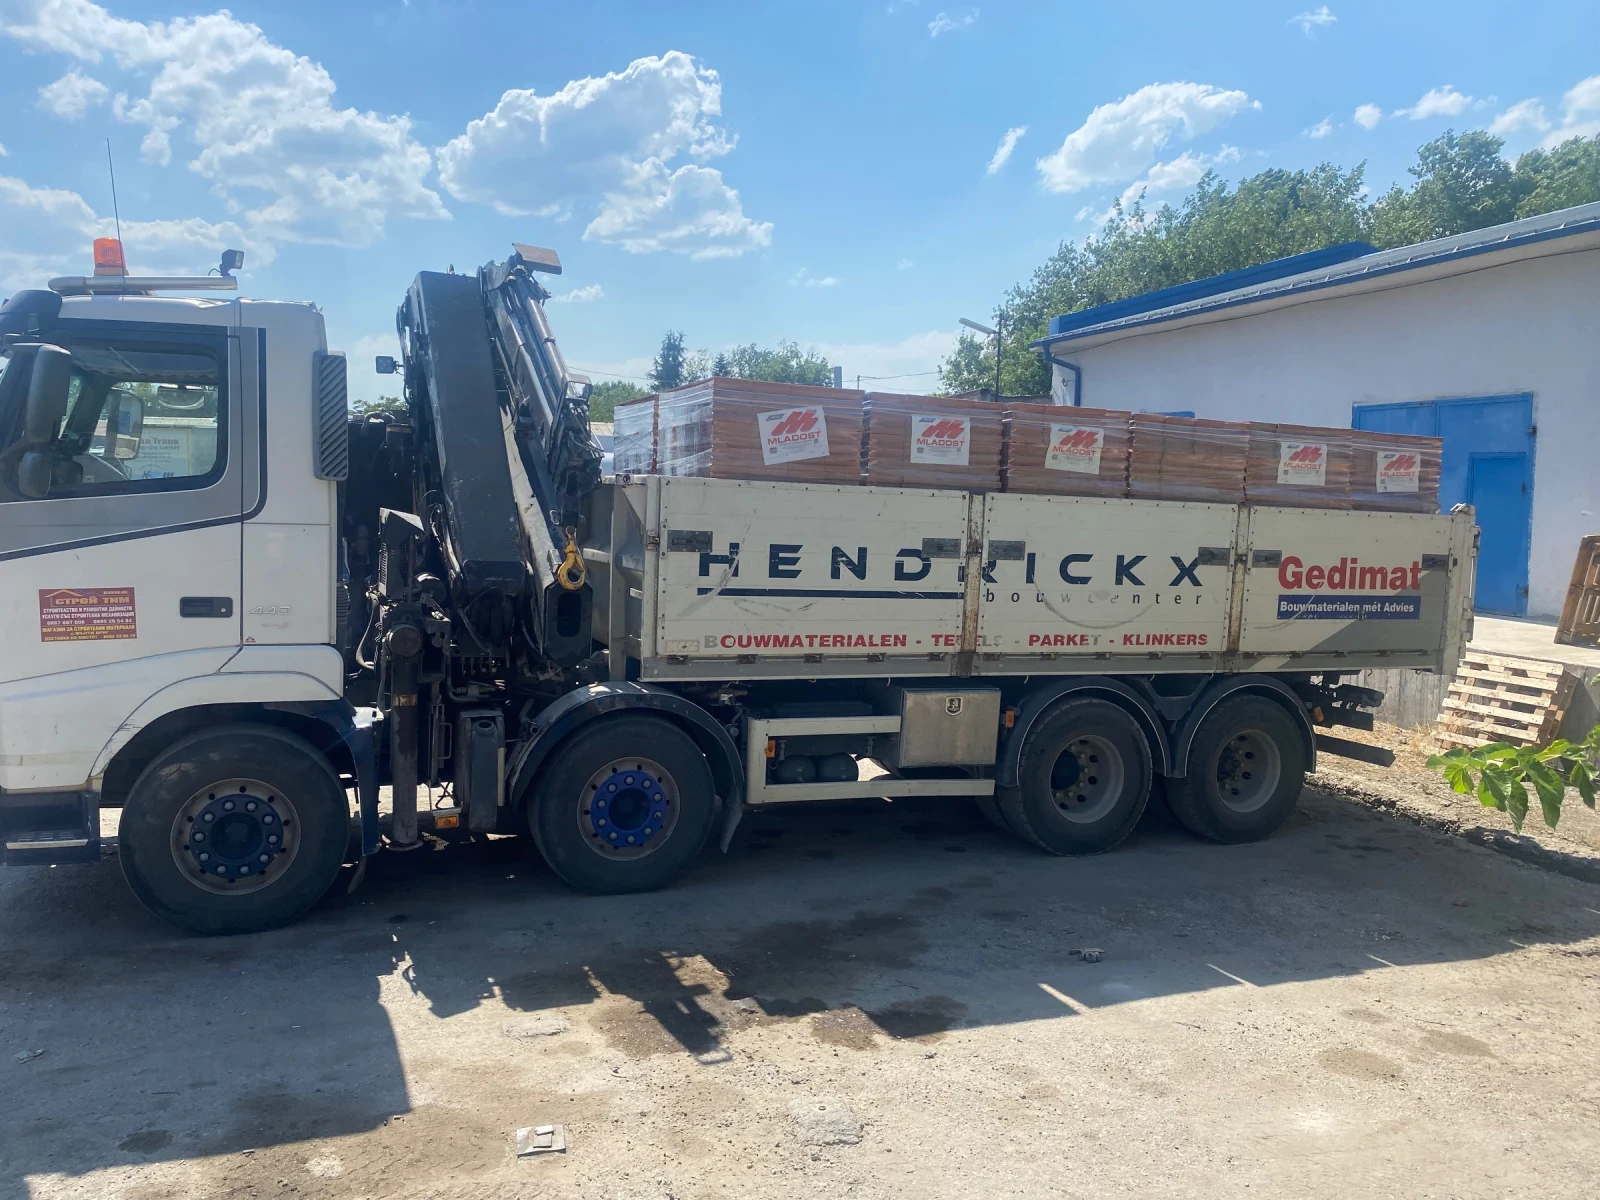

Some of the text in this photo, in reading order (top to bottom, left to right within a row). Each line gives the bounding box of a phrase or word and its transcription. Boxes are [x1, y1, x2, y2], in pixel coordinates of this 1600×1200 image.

[767, 430, 822, 446] MLADOST
[916, 438, 965, 448] MLADOST
[1052, 446, 1097, 457] MLADOST
[1283, 462, 1323, 471] MLADOST
[1278, 556, 1422, 591] Gedimat
[55, 596, 130, 605] СТРОЙ ТИМ
[249, 606, 292, 616] 440
[1280, 601, 1414, 613] Bouwmaterialen mét Advies
[704, 634, 907, 649] BOUWMATERIALEN
[1028, 633, 1102, 647] PARKET
[1123, 633, 1208, 646] KLINKERS
